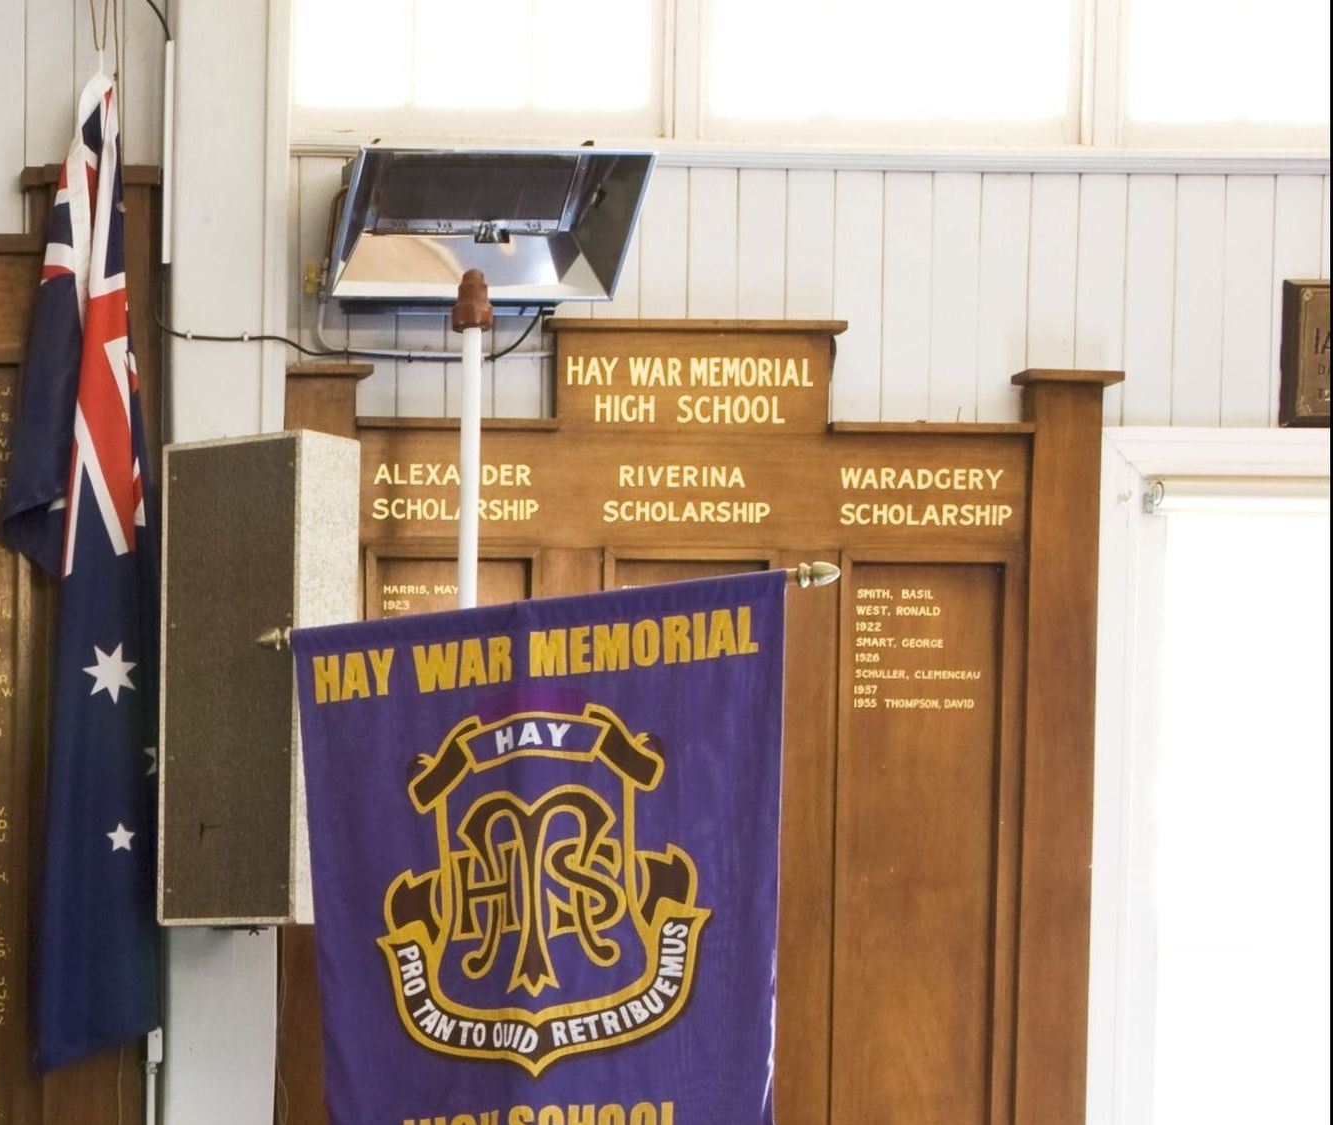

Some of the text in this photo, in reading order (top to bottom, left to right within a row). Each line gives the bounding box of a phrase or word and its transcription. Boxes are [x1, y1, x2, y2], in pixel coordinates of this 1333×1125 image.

[568, 357, 813, 386] HAY WAR MEMORIAL
[595, 395, 785, 423] HIGH SCHOOL
[373, 463, 531, 486] ALEXADER
[620, 465, 745, 488] RIVERINA
[841, 468, 1003, 489] WARADGERY
[372, 498, 539, 520] SCHOLRSHIP
[603, 501, 770, 523] SCHOLARSHIP
[840, 503, 1012, 525] SCHOLARSHIP
[384, 585, 459, 595] HARRIS, MAY
[902, 589, 933, 599] BASIL
[384, 600, 410, 610] 1923
[896, 606, 940, 616] RONALD
[856, 622, 881, 631] 1922
[313, 605, 759, 703] HAY WAR MEMORIAL
[902, 639, 943, 648] GEORGE
[856, 653, 880, 662] 1926
[856, 669, 980, 679] SCHULLER, CLEMENCEAU
[944, 699, 974, 708] DAVID
[495, 722, 572, 755] HAY
[397, 945, 426, 996] PRO
[551, 921, 688, 1047] RETRIBUEMUS
